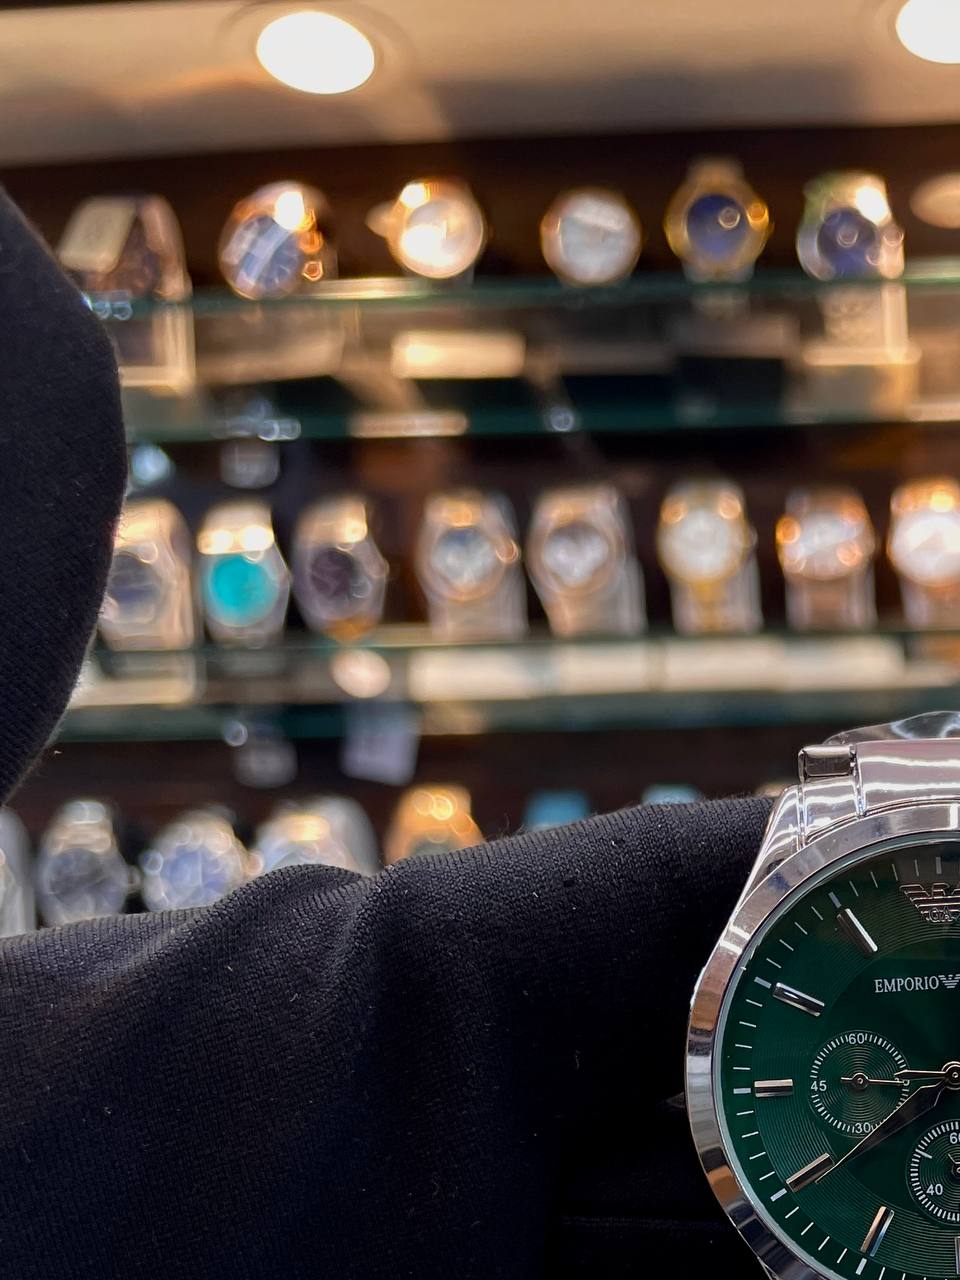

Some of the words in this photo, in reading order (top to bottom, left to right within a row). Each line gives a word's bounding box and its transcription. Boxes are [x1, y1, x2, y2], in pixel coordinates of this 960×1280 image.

[874, 975, 939, 993] EMPORIO
[848, 1033, 865, 1045] 60
[810, 1080, 827, 1092] 45
[855, 1122, 871, 1134] 30
[926, 1183, 944, 1196] 40
